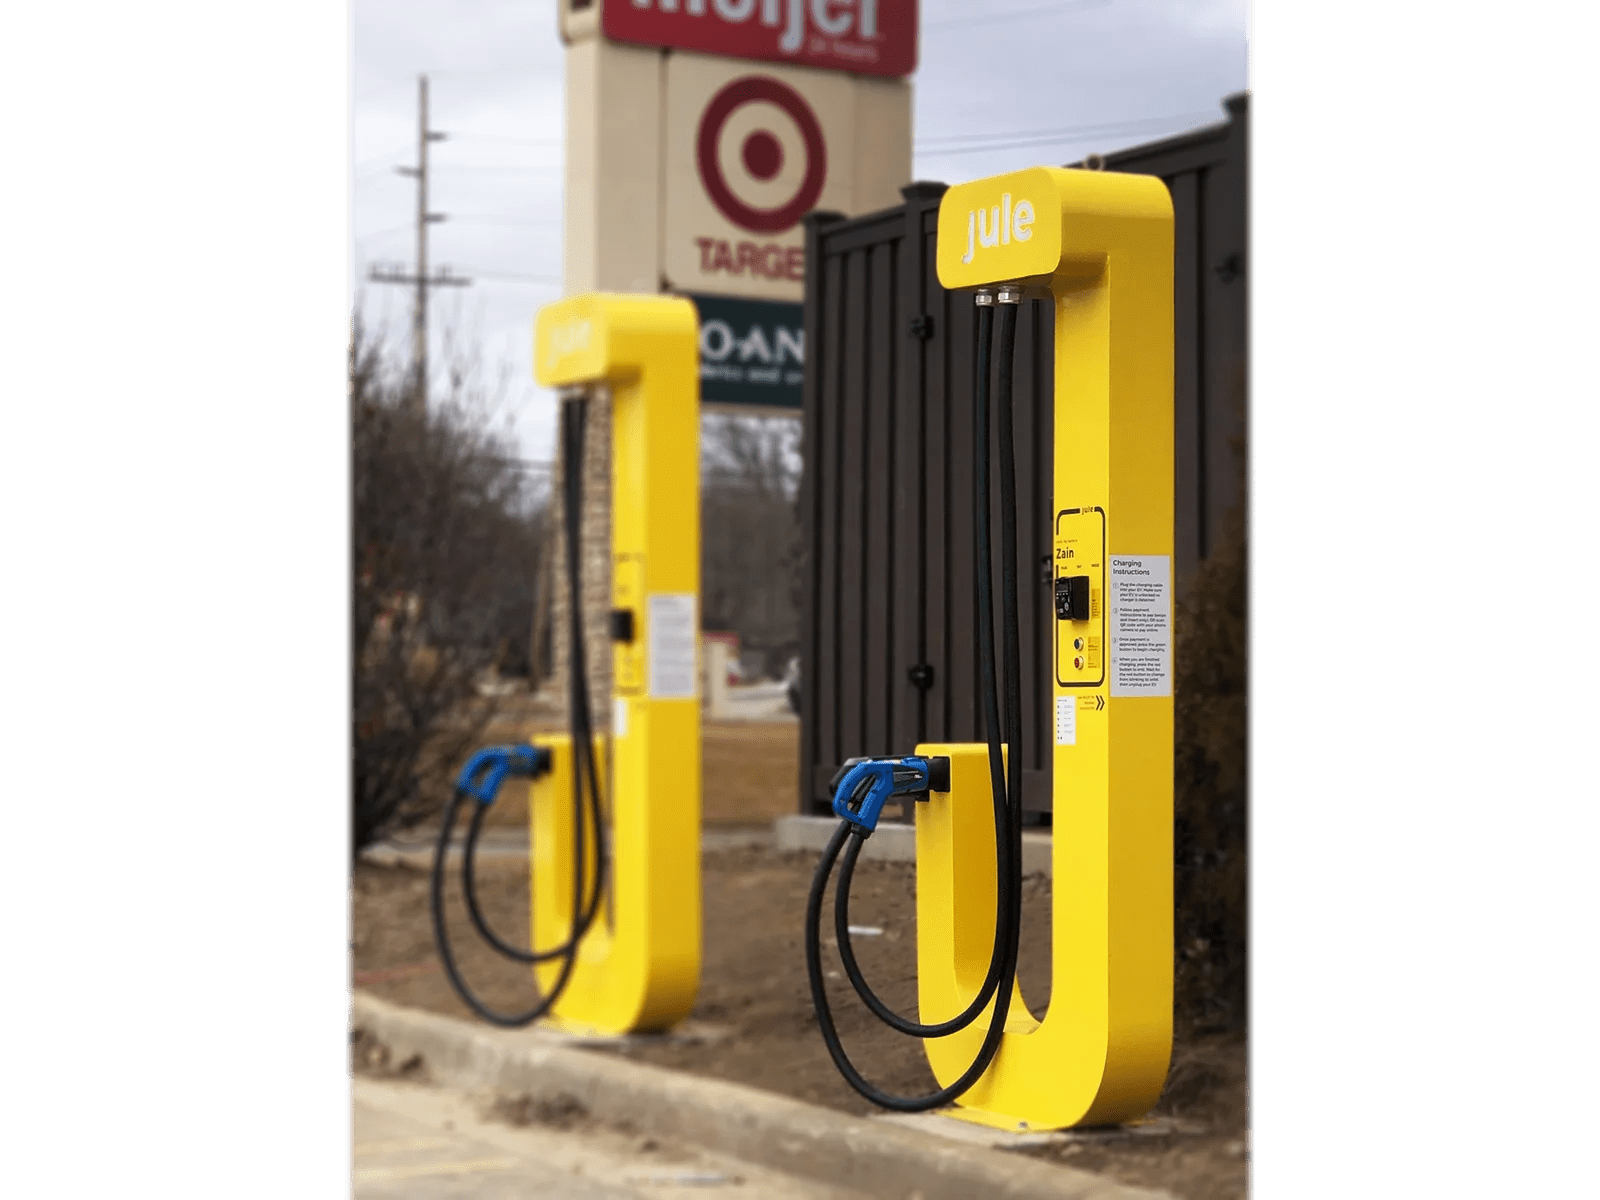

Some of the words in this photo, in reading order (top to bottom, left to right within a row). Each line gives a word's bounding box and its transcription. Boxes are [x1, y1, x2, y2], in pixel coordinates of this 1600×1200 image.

[961, 193, 1035, 265] jule
[696, 237, 805, 281] TARGE
[1081, 506, 1093, 515] jule
[1056, 547, 1074, 559] Zain
[1112, 559, 1142, 567] Charging
[1112, 568, 1150, 576] Instructions
